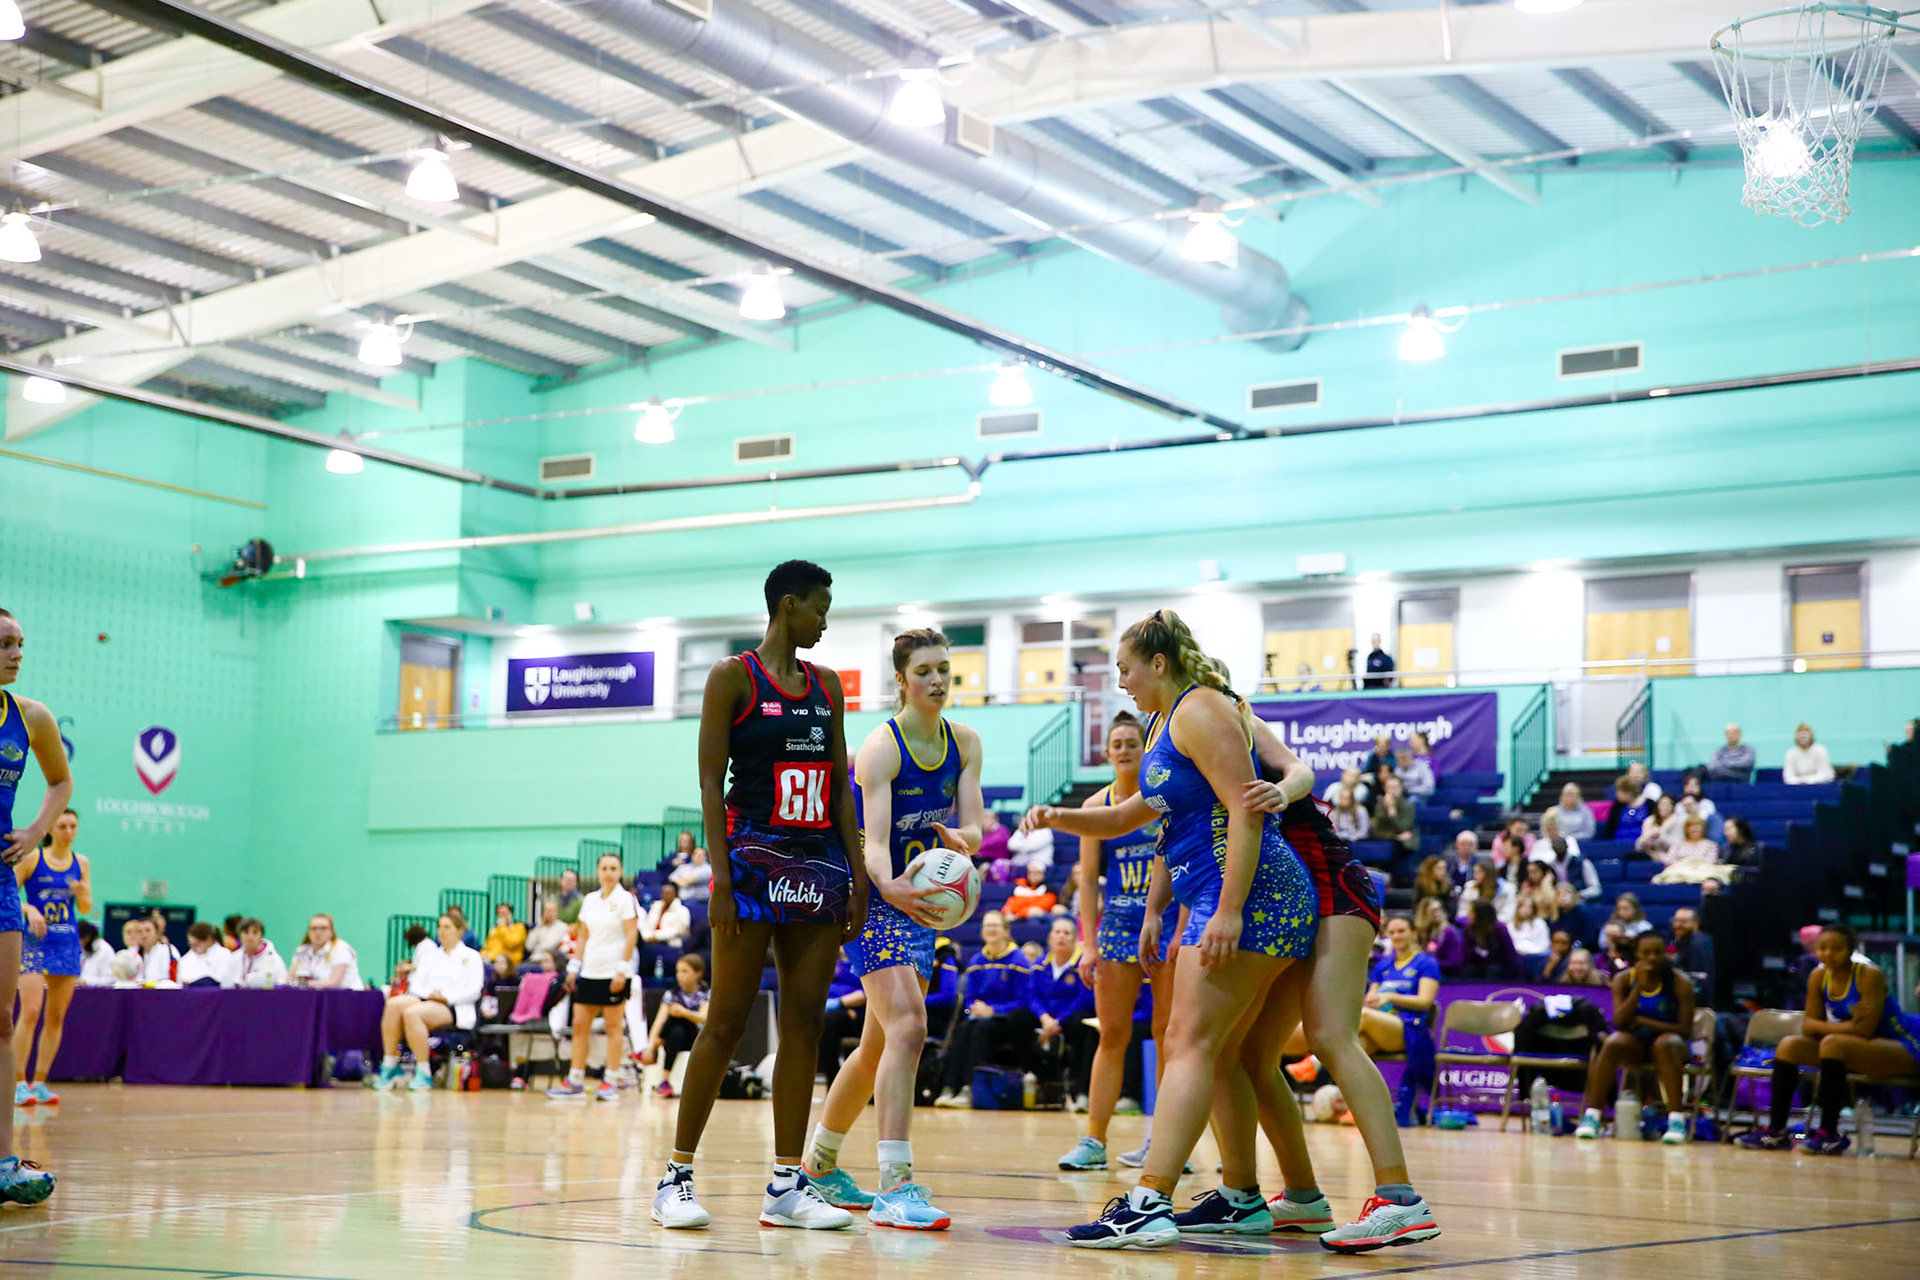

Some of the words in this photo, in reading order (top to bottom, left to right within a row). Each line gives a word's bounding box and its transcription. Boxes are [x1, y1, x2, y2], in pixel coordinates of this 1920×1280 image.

[552, 662, 637, 683] Loughborough
[551, 682, 611, 700] University
[1290, 715, 1452, 749] Loughborough
[786, 743, 825, 753] Strathclyde
[779, 768, 826, 822] GK
[96, 797, 210, 821] LOUGHBOROUGH
[121, 819, 186, 833] SPORT
[768, 876, 824, 913] Vitality
